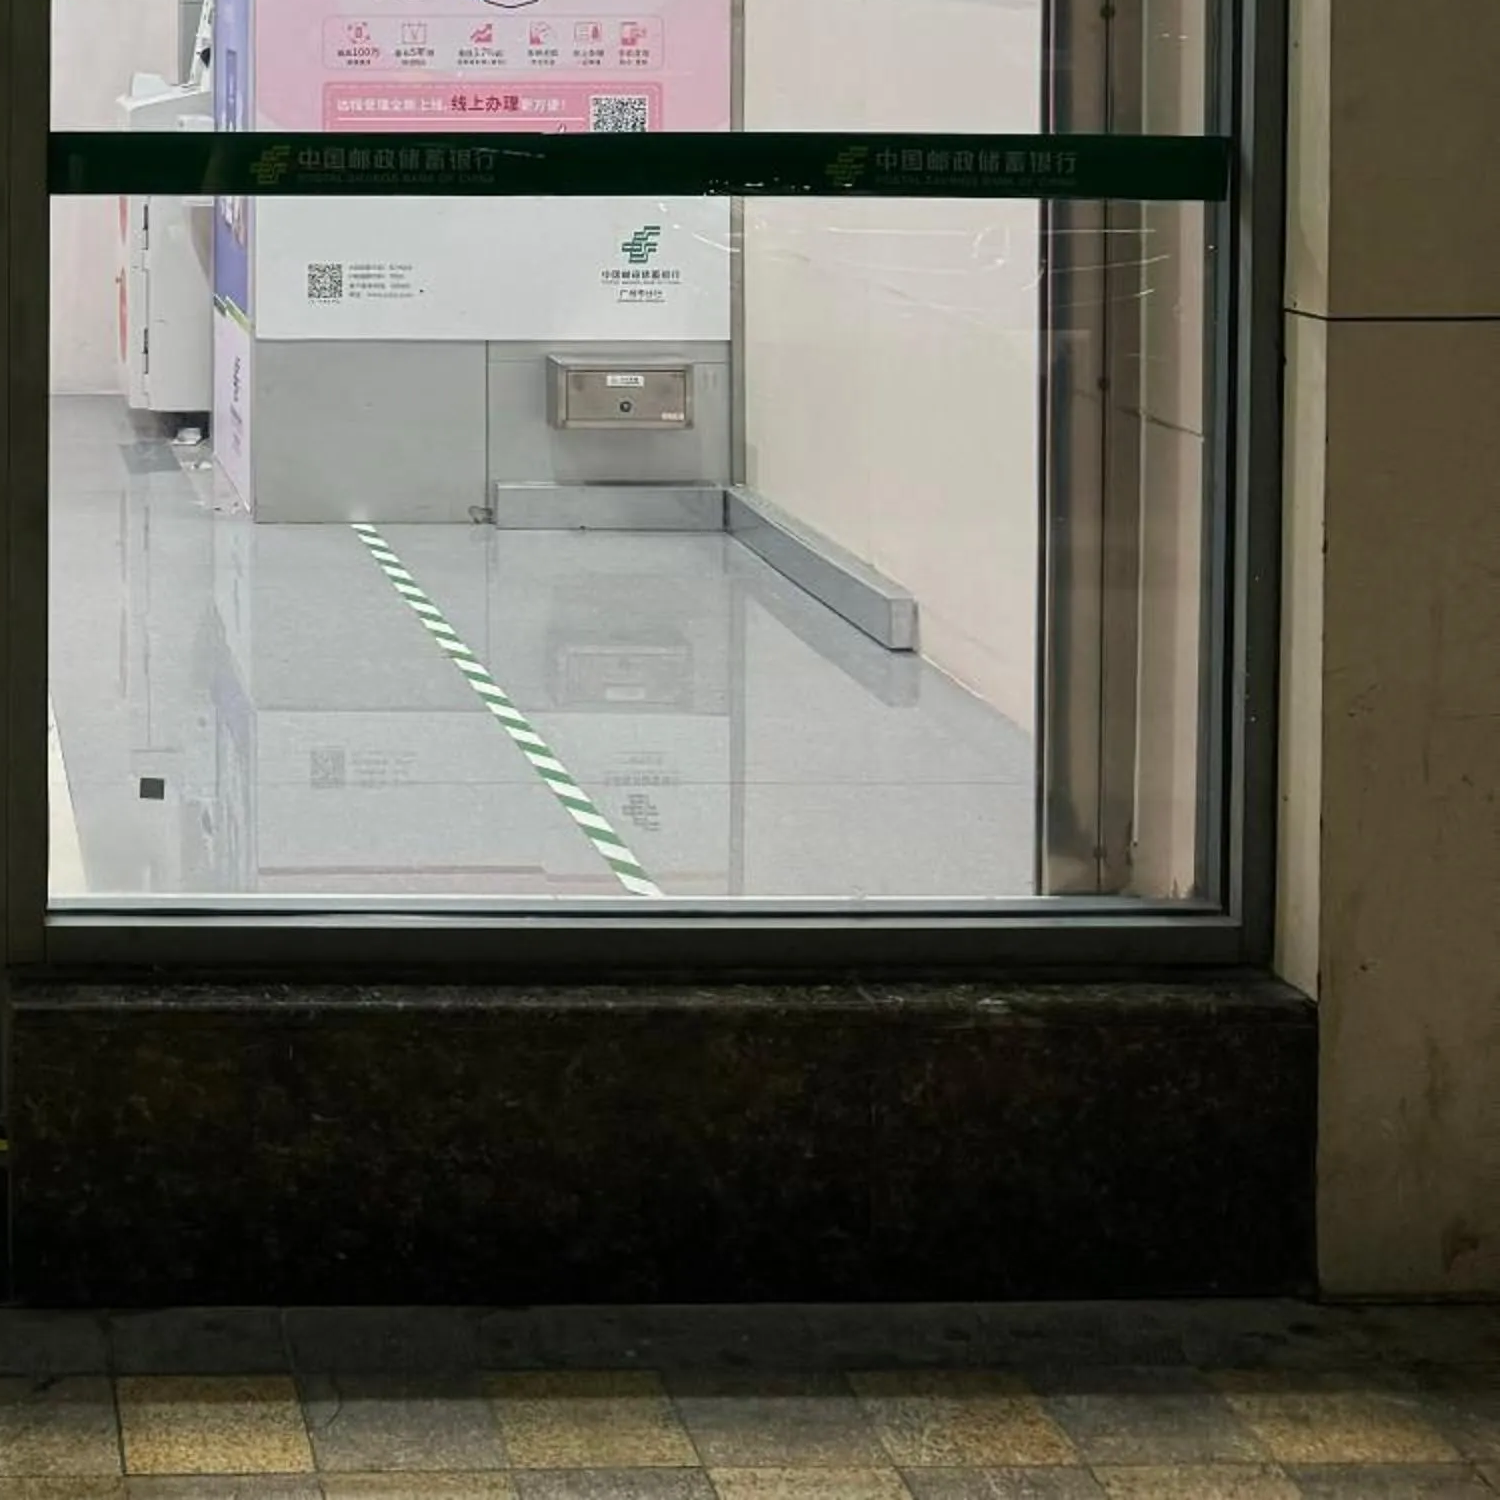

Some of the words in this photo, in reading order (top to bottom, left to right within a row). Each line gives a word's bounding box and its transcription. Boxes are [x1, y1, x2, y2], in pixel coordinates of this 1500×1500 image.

[298, 146, 494, 171] 中国邮政储蓄银行
[875, 148, 1078, 175] 中国邮政储蓄银行
